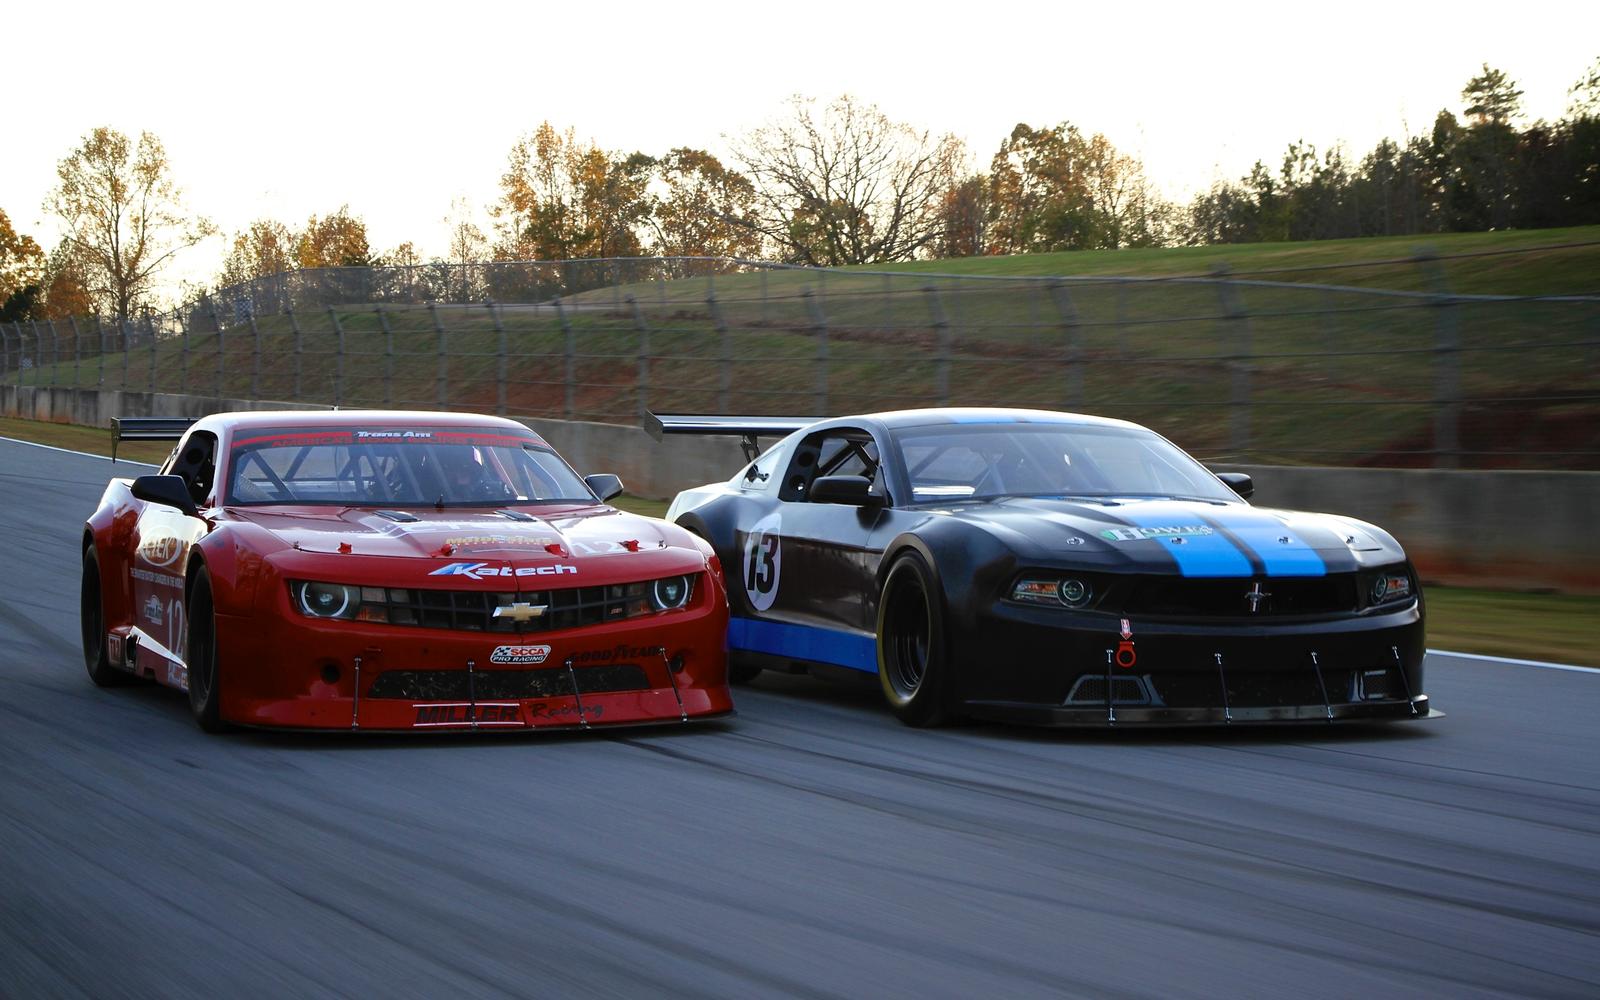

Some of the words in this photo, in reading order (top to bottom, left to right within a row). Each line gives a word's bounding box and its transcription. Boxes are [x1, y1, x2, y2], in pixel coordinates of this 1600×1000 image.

[747, 527, 779, 594] 13
[450, 562, 578, 580] Katech
[510, 647, 545, 656] SCCA
[415, 704, 519, 722] MILLER
